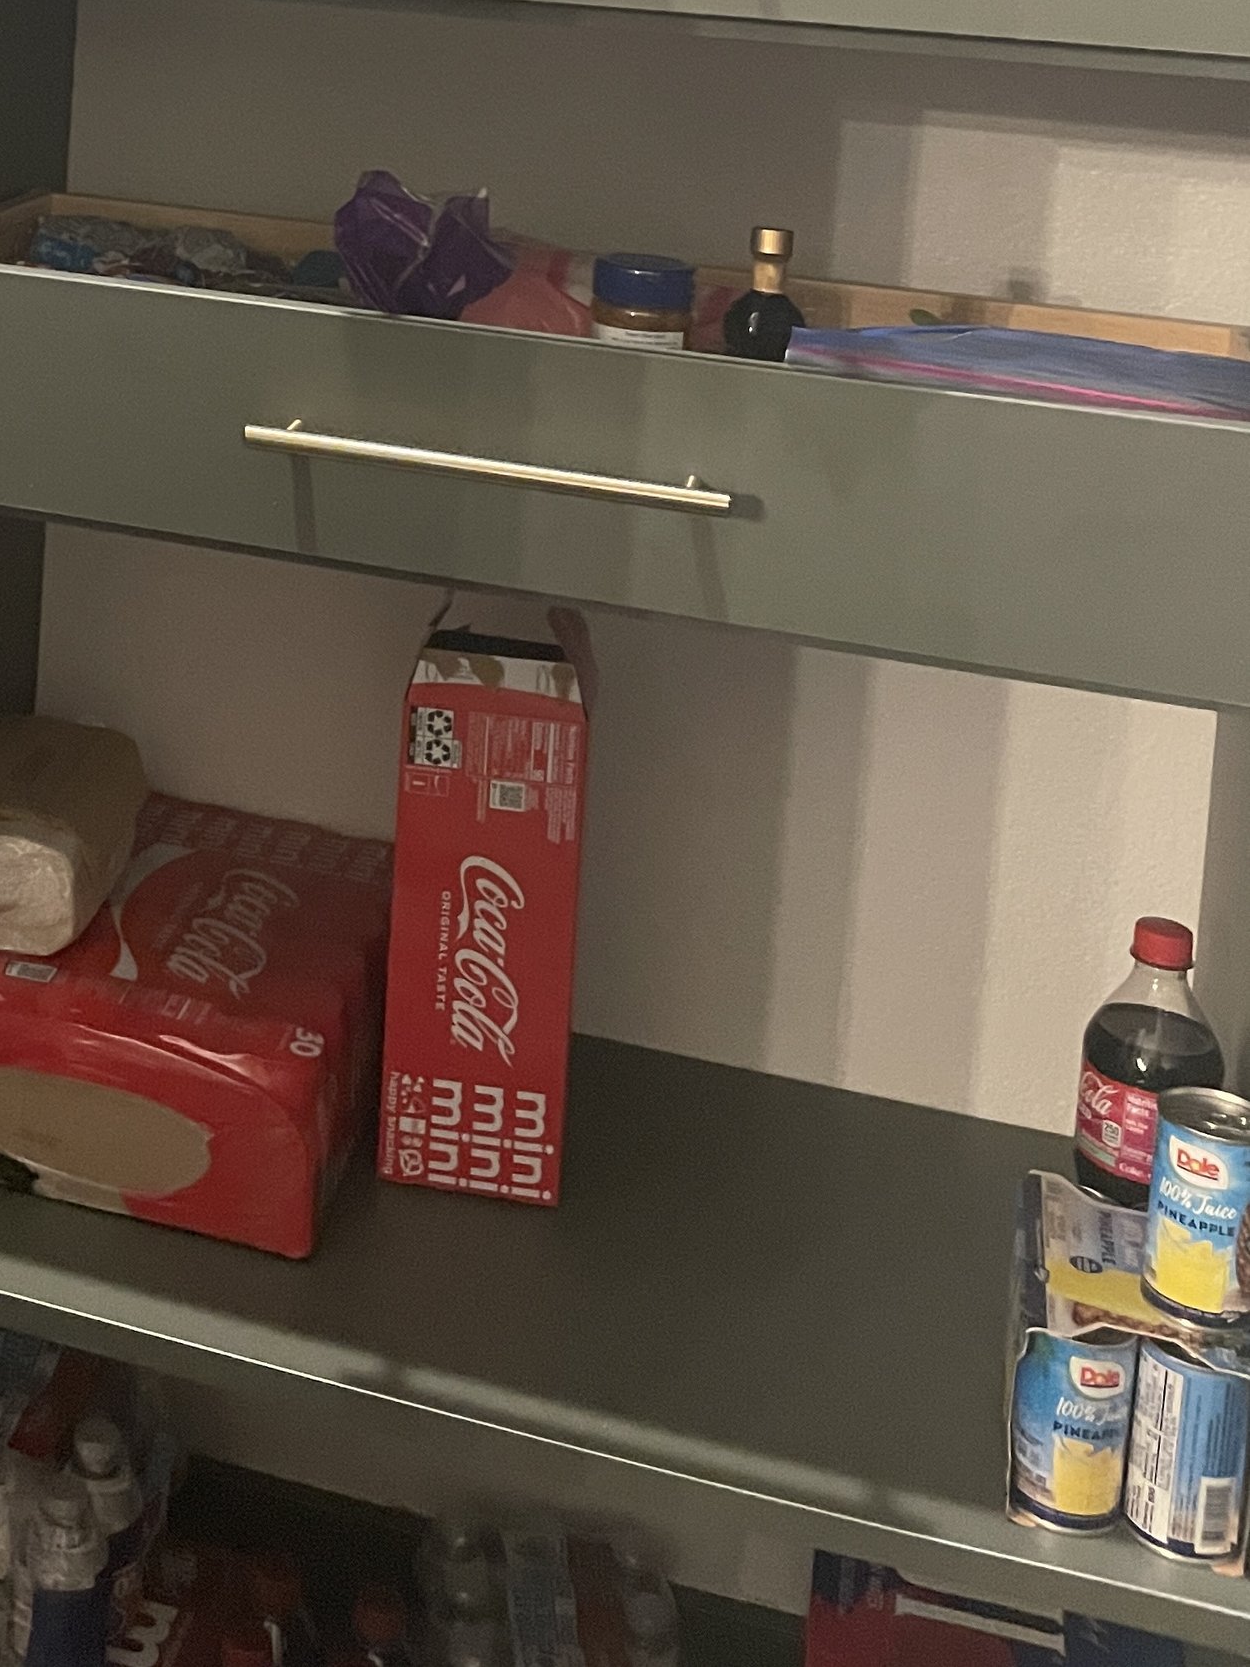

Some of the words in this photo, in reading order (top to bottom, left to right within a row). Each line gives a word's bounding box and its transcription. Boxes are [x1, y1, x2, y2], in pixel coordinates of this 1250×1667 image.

[437, 889, 452, 961] ORIGINAL
[434, 966, 449, 1012] TASTE
[288, 1025, 326, 1059] 30
[426, 1077, 469, 1187] mini
[469, 1083, 510, 1195] mini
[511, 1089, 553, 1201] mini
[1177, 1148, 1220, 1177] Dole
[1157, 1199, 1235, 1237] PINEAPPLE
[1158, 1175, 1193, 1209] 100%
[1192, 1193, 1238, 1220] Juice
[1080, 1366, 1121, 1385] Dole
[1055, 1396, 1096, 1423] 100%
